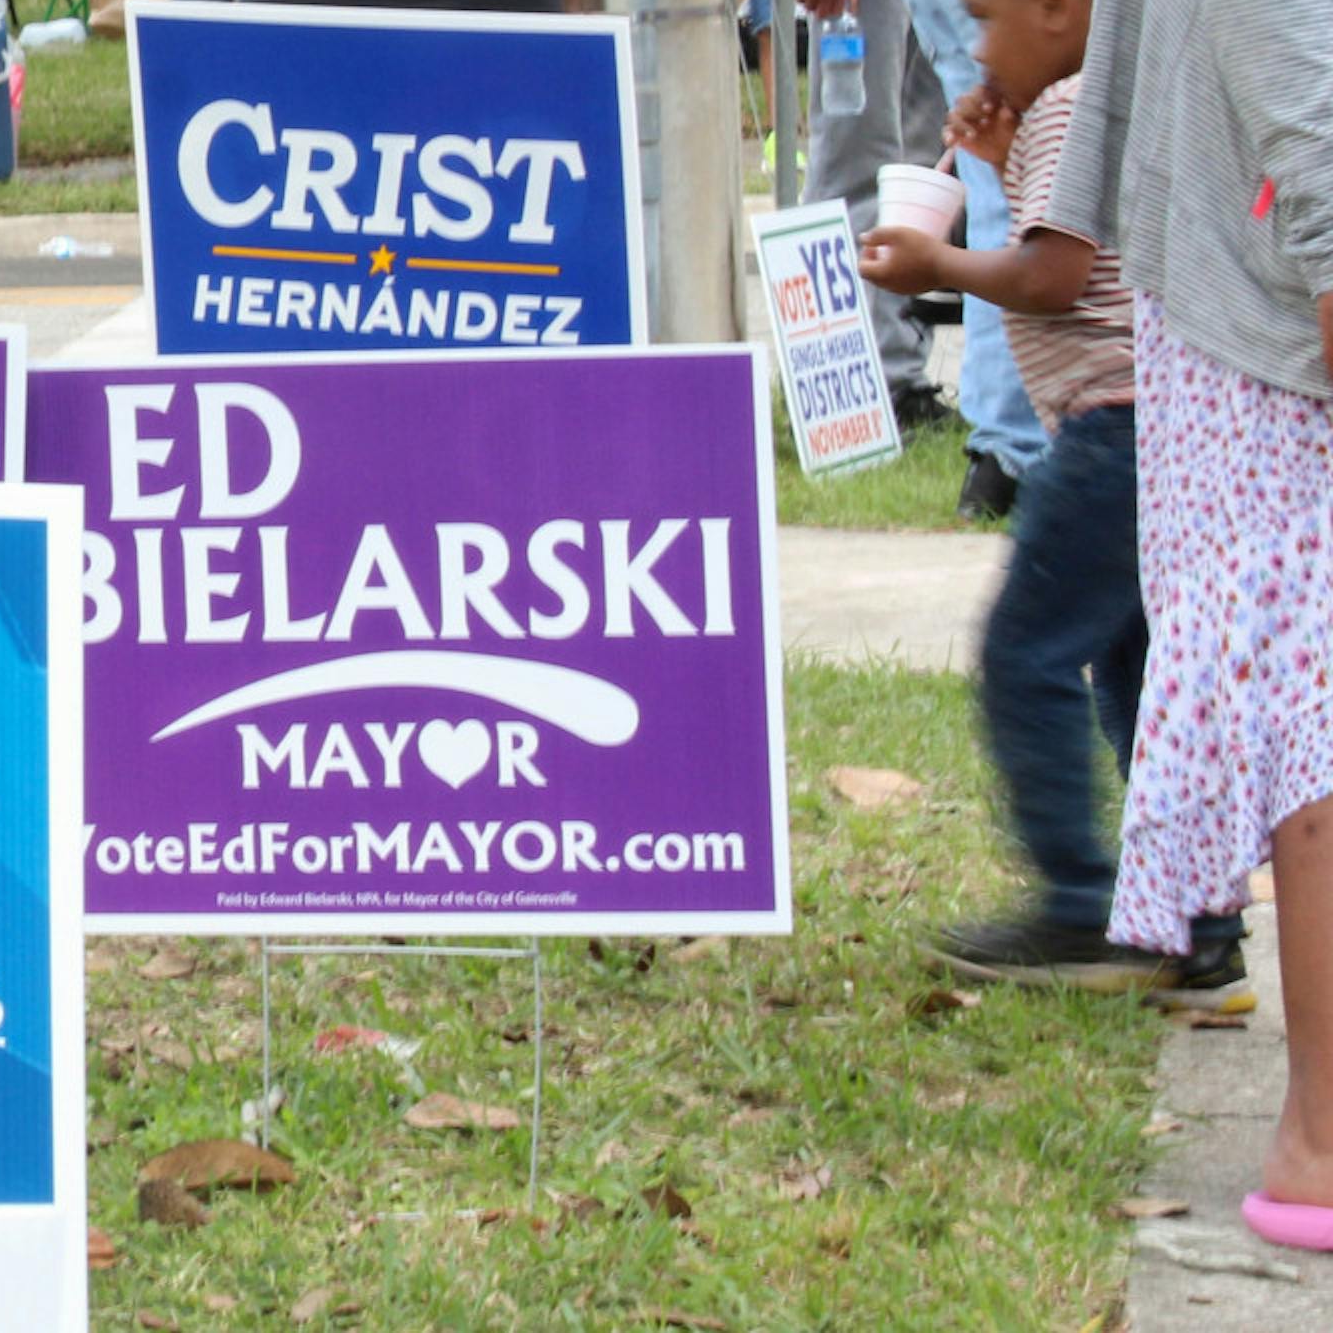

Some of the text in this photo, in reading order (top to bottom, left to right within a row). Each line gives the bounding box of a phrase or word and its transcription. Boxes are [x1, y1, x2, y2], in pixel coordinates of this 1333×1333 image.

[177, 97, 586, 244] CRIST
[191, 274, 583, 346] HERNÁNDEZ
[773, 234, 858, 325] VOTE YES
[790, 328, 867, 372] SINGLE-MEMBER
[797, 362, 877, 422] DISTRICTS
[104, 381, 302, 521] ED
[808, 411, 874, 459] NOVEMBER
[83, 517, 735, 645] BIELARSKI
[403, 891, 439, 910] Mayor
